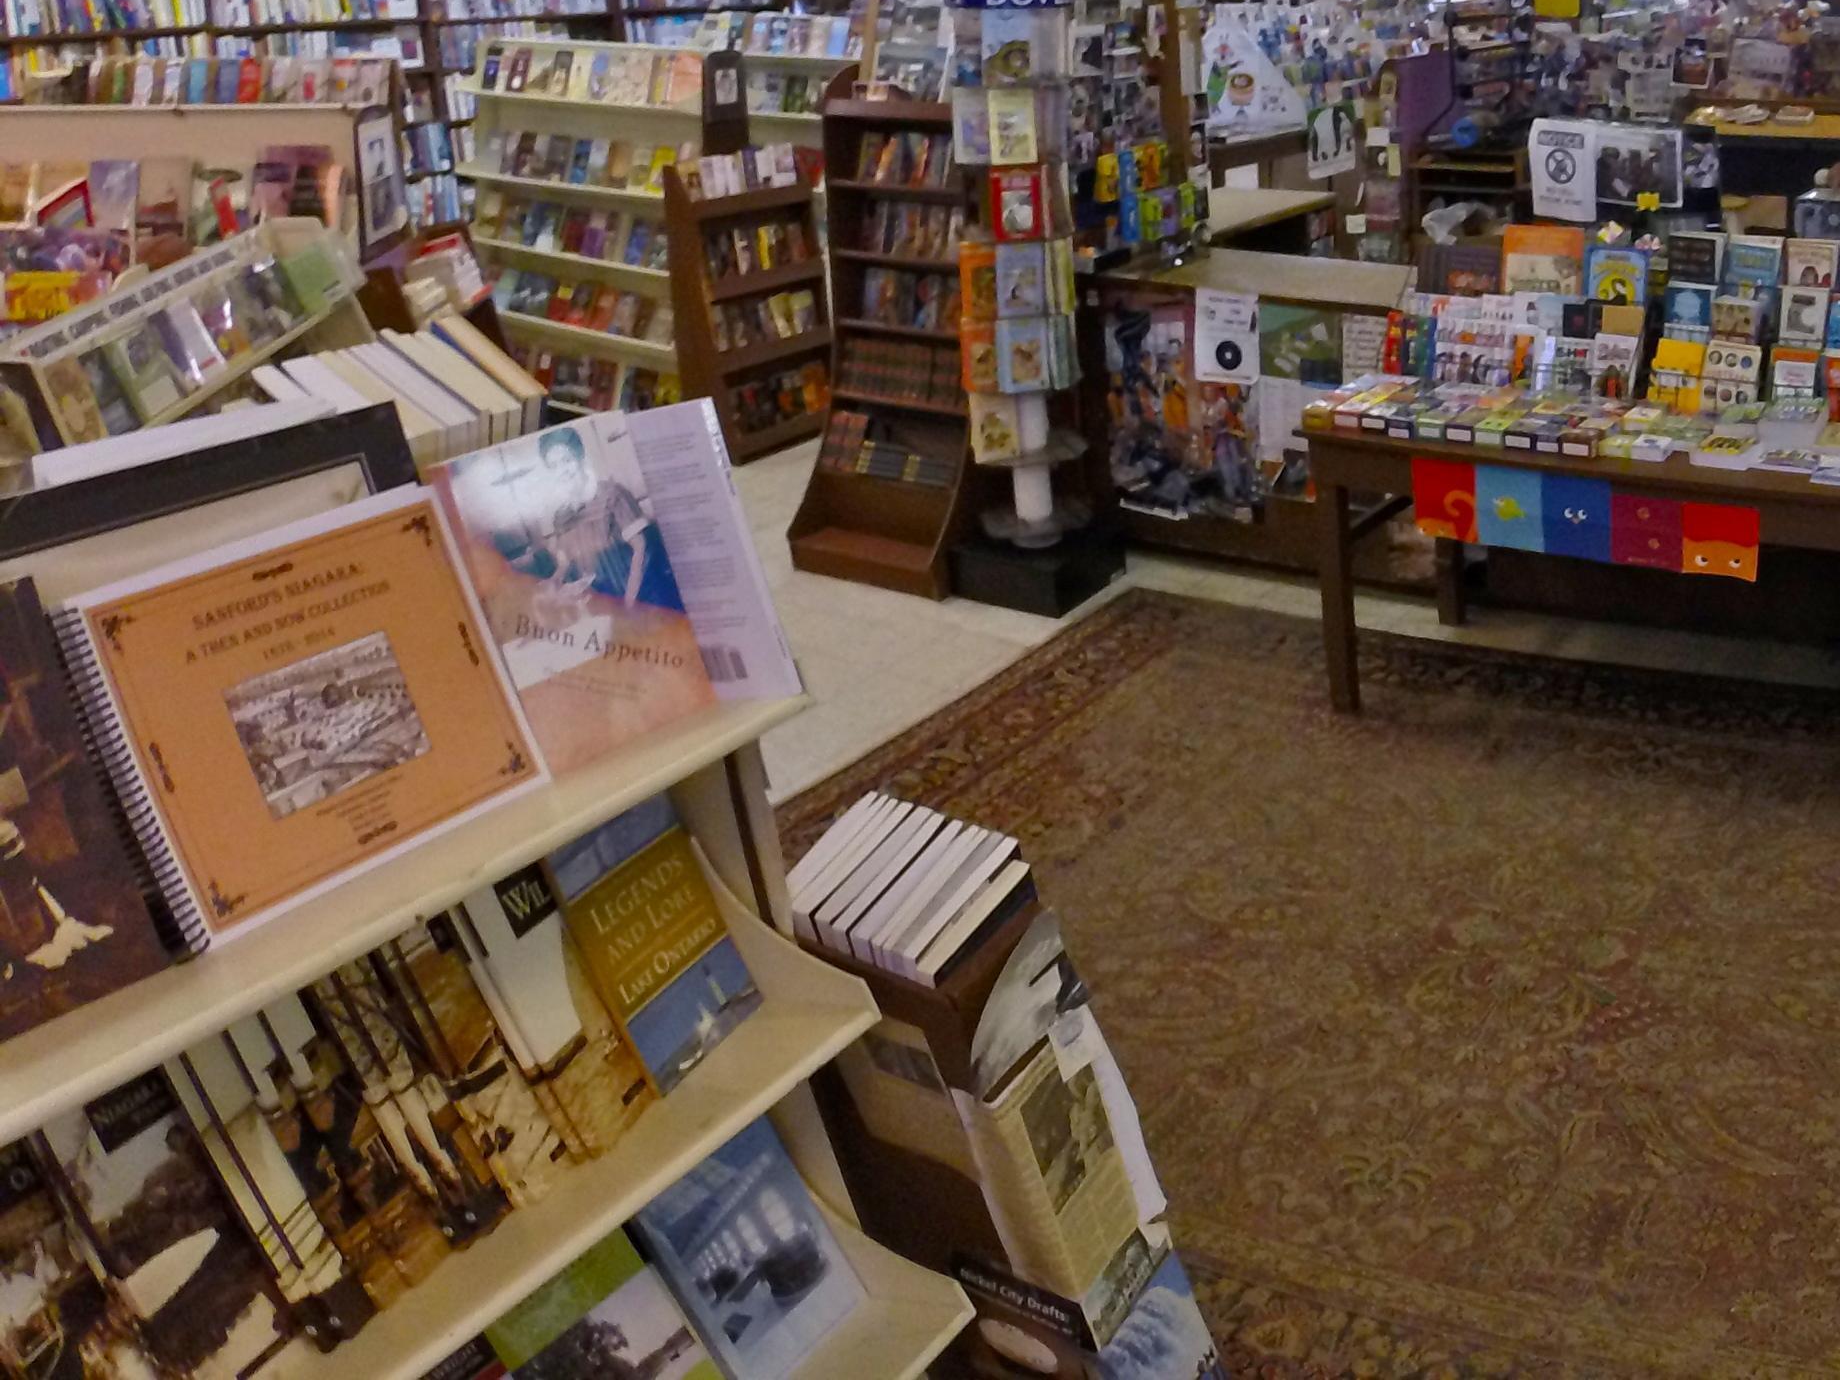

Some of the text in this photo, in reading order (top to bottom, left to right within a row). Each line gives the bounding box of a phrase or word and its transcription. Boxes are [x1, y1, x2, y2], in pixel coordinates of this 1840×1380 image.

[513, 613, 684, 670] Buon Appetito
[589, 856, 684, 935] LEGENDS
[606, 883, 696, 966] AND LORE
[619, 918, 717, 1005] LAKE ONTARIO
